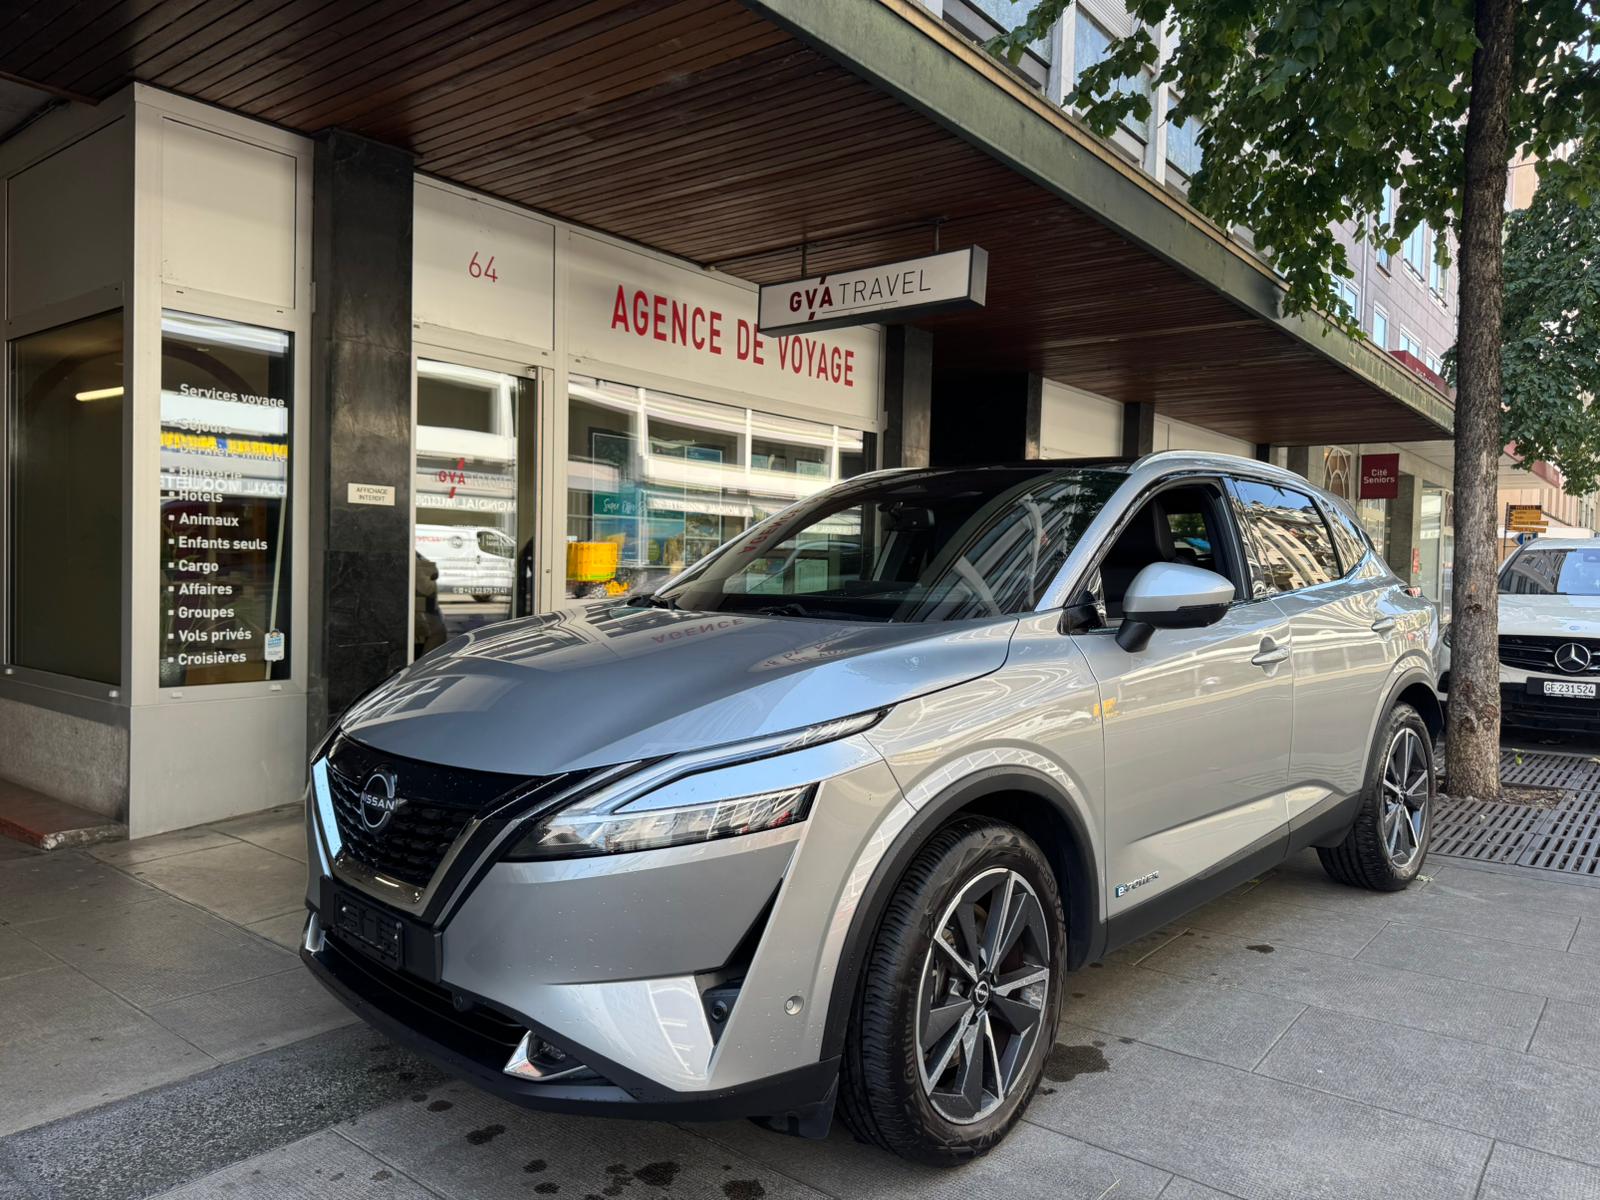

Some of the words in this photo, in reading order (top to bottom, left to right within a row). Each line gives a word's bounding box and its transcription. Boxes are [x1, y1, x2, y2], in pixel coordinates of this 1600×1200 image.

[469, 251, 498, 283] 64
[789, 281, 833, 316] GVA
[839, 269, 931, 305] TRAVEL
[610, 284, 722, 355] AGENCE
[736, 318, 764, 365] DE
[778, 335, 855, 387] VOYAGE
[180, 383, 238, 401] Services
[240, 393, 285, 408] voyage
[1371, 467, 1388, 477] Cité
[1363, 476, 1395, 484] Seniors
[179, 512, 240, 527] Animaux
[178, 536, 230, 550] Enfants
[232, 538, 268, 550] seuls
[178, 559, 219, 575] Cargo
[178, 583, 233, 595] Affaires
[178, 606, 235, 620] Groupes
[178, 629, 208, 642] Vols
[211, 627, 252, 643] privés
[178, 650, 247, 665] Croisières
